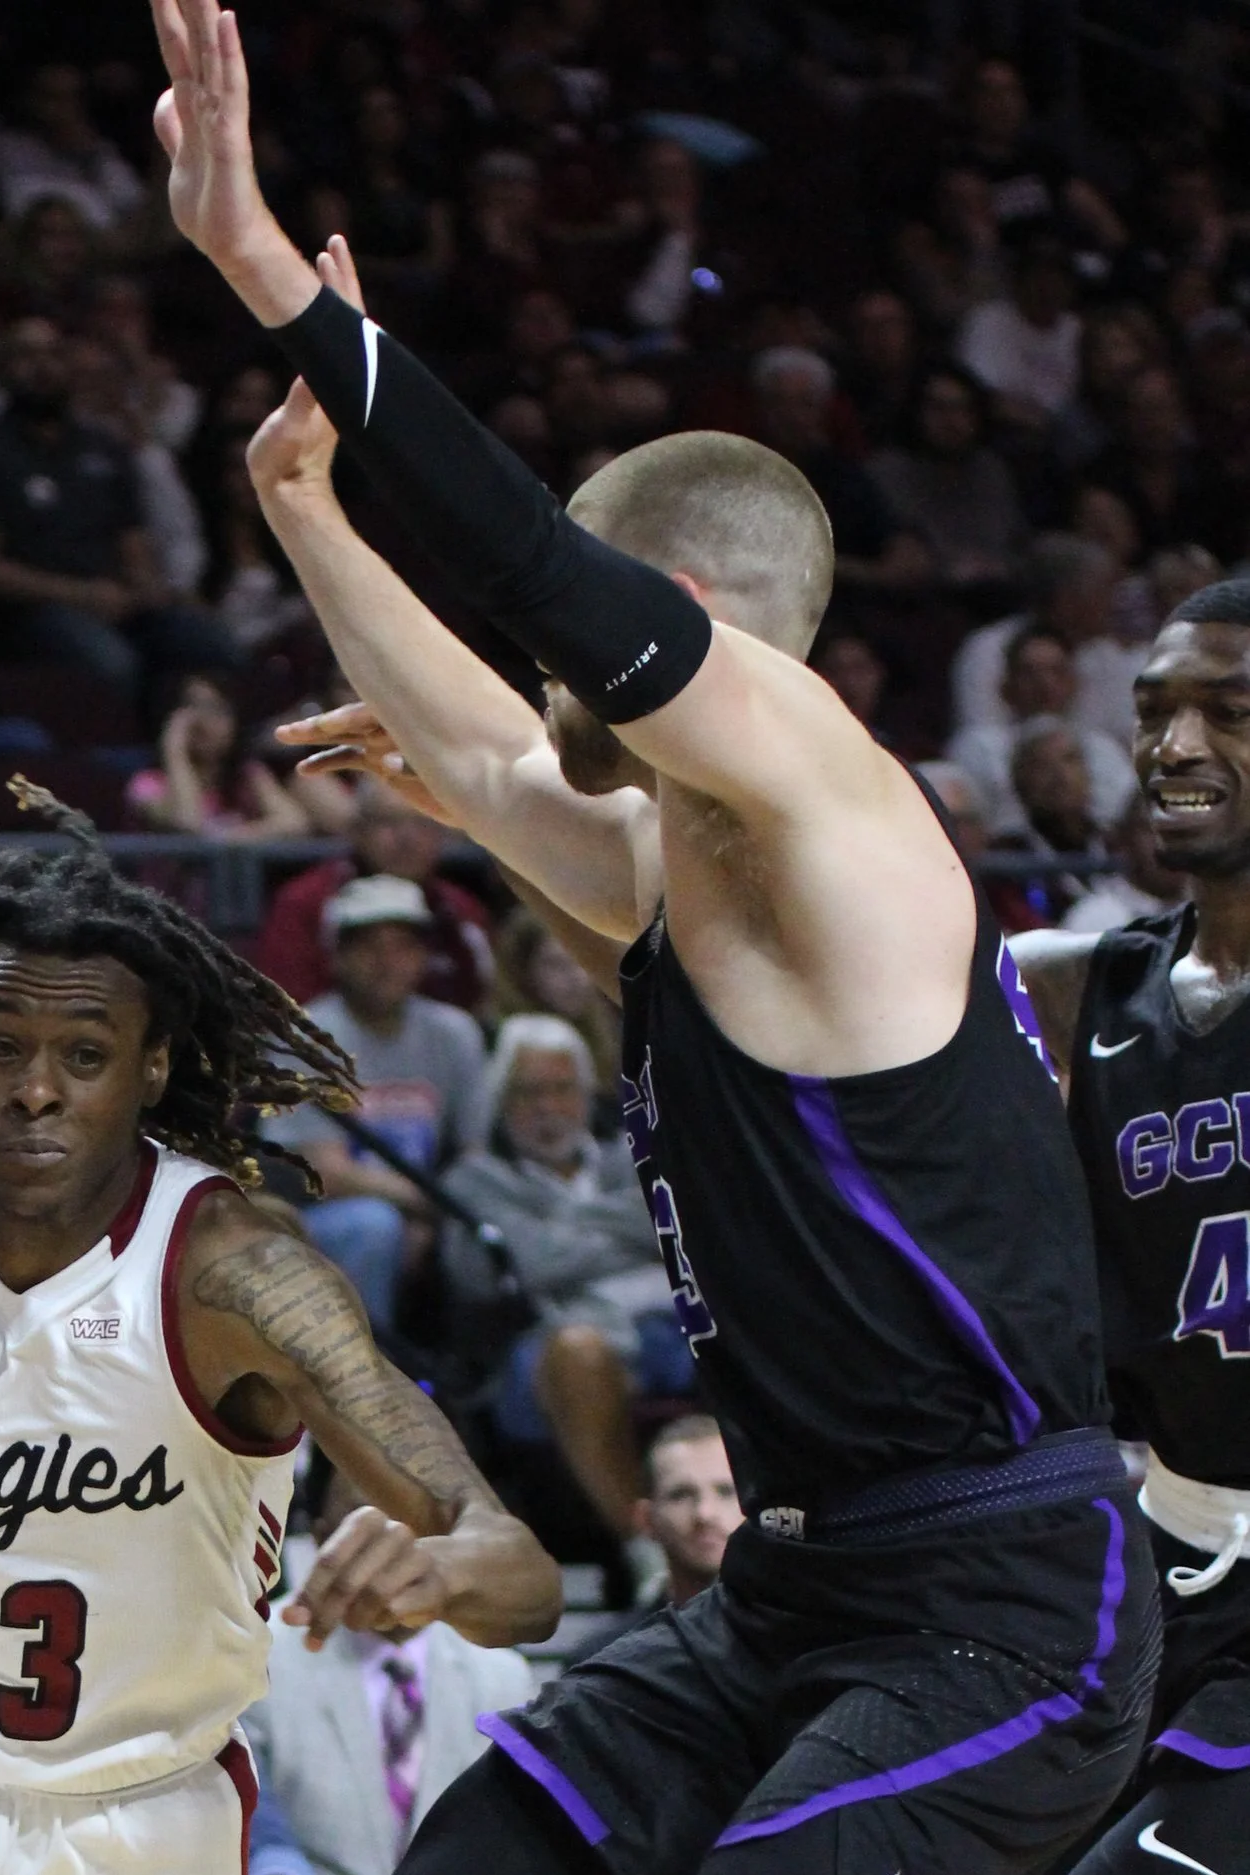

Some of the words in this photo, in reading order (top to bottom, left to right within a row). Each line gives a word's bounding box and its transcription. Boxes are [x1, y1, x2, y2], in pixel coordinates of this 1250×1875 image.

[605, 640, 659, 692] DRI-FIT
[1173, 1209, 1250, 1360] 4
[69, 1318, 120, 1340] WAC
